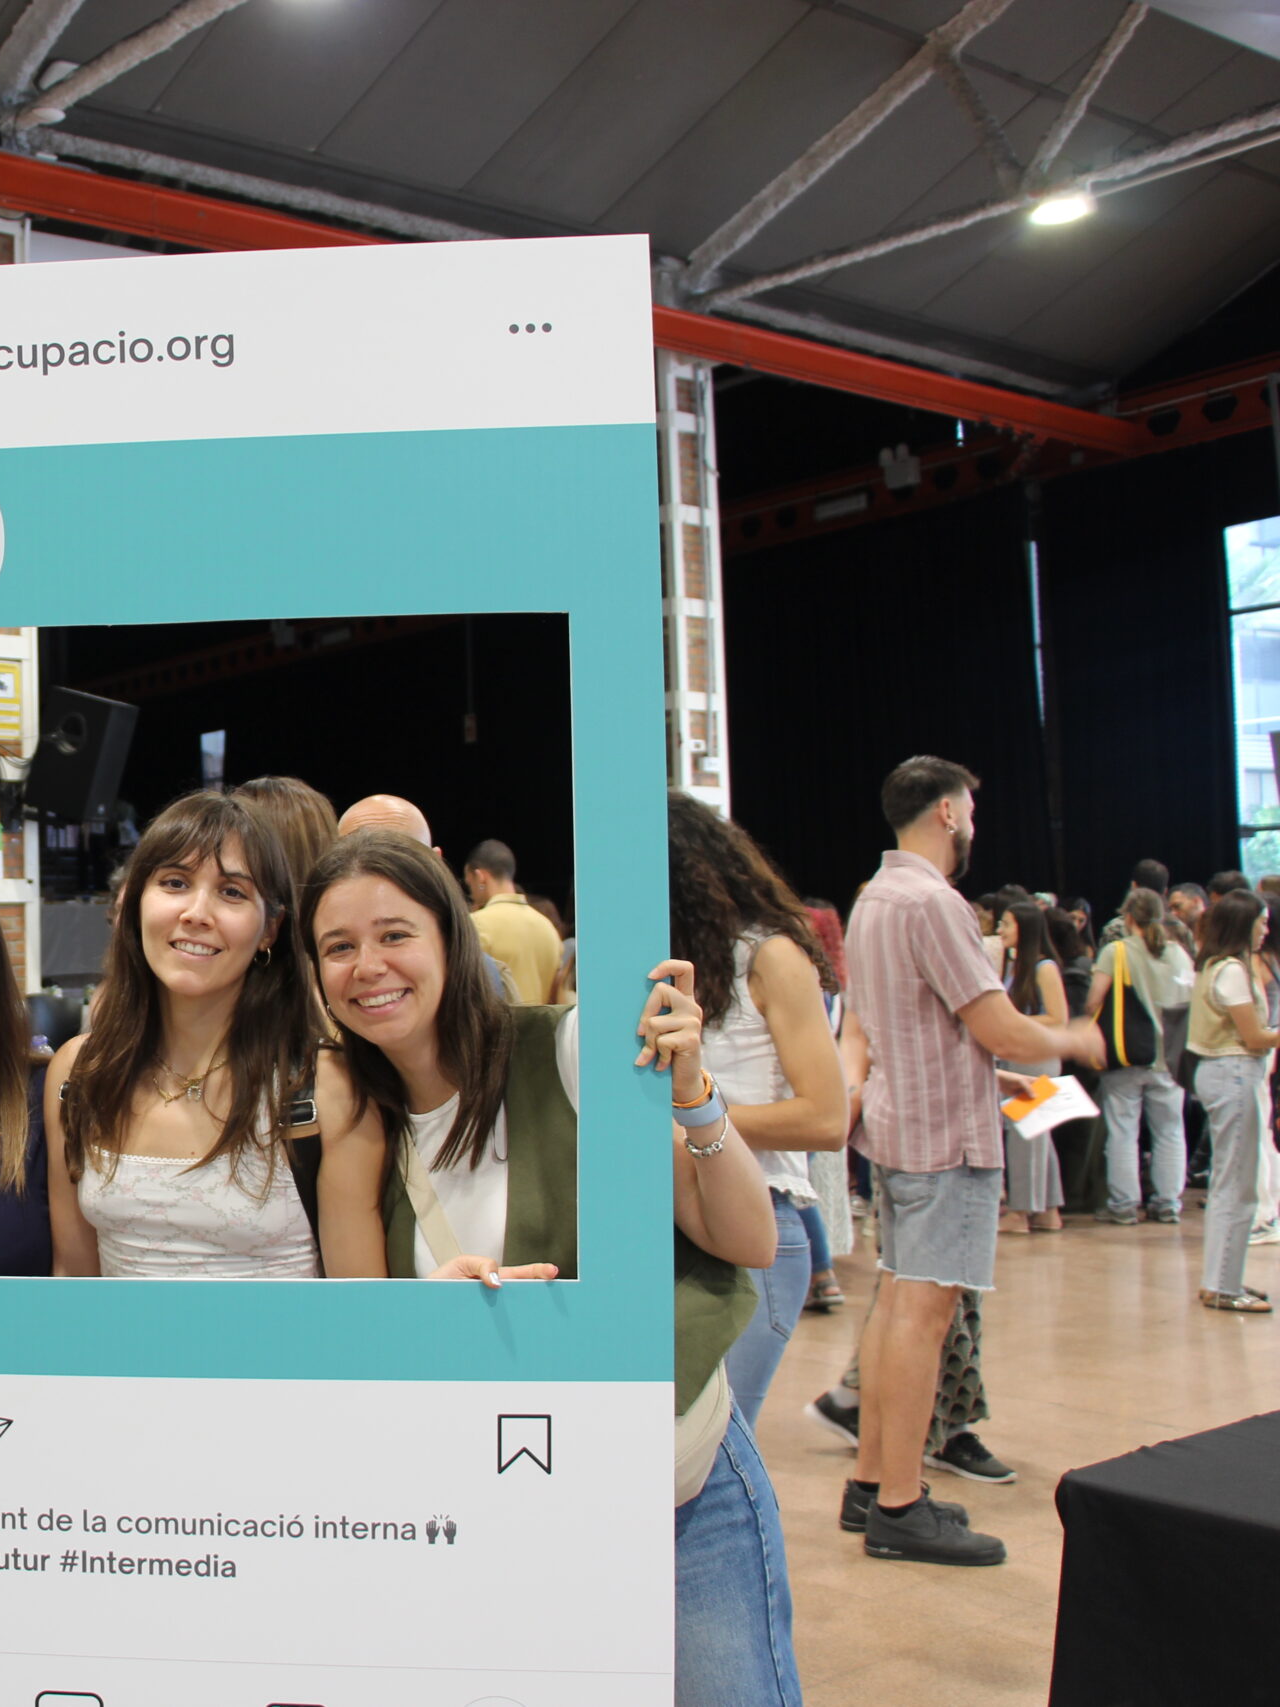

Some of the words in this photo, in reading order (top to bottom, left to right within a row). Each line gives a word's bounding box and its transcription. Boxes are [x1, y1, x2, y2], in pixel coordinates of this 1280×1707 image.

[36, 1507, 74, 1532] de
[82, 1508, 107, 1534] la
[116, 1512, 305, 1539] comunicació
[314, 1514, 417, 1541] interna
[59, 1549, 237, 1579] #Intermedia
